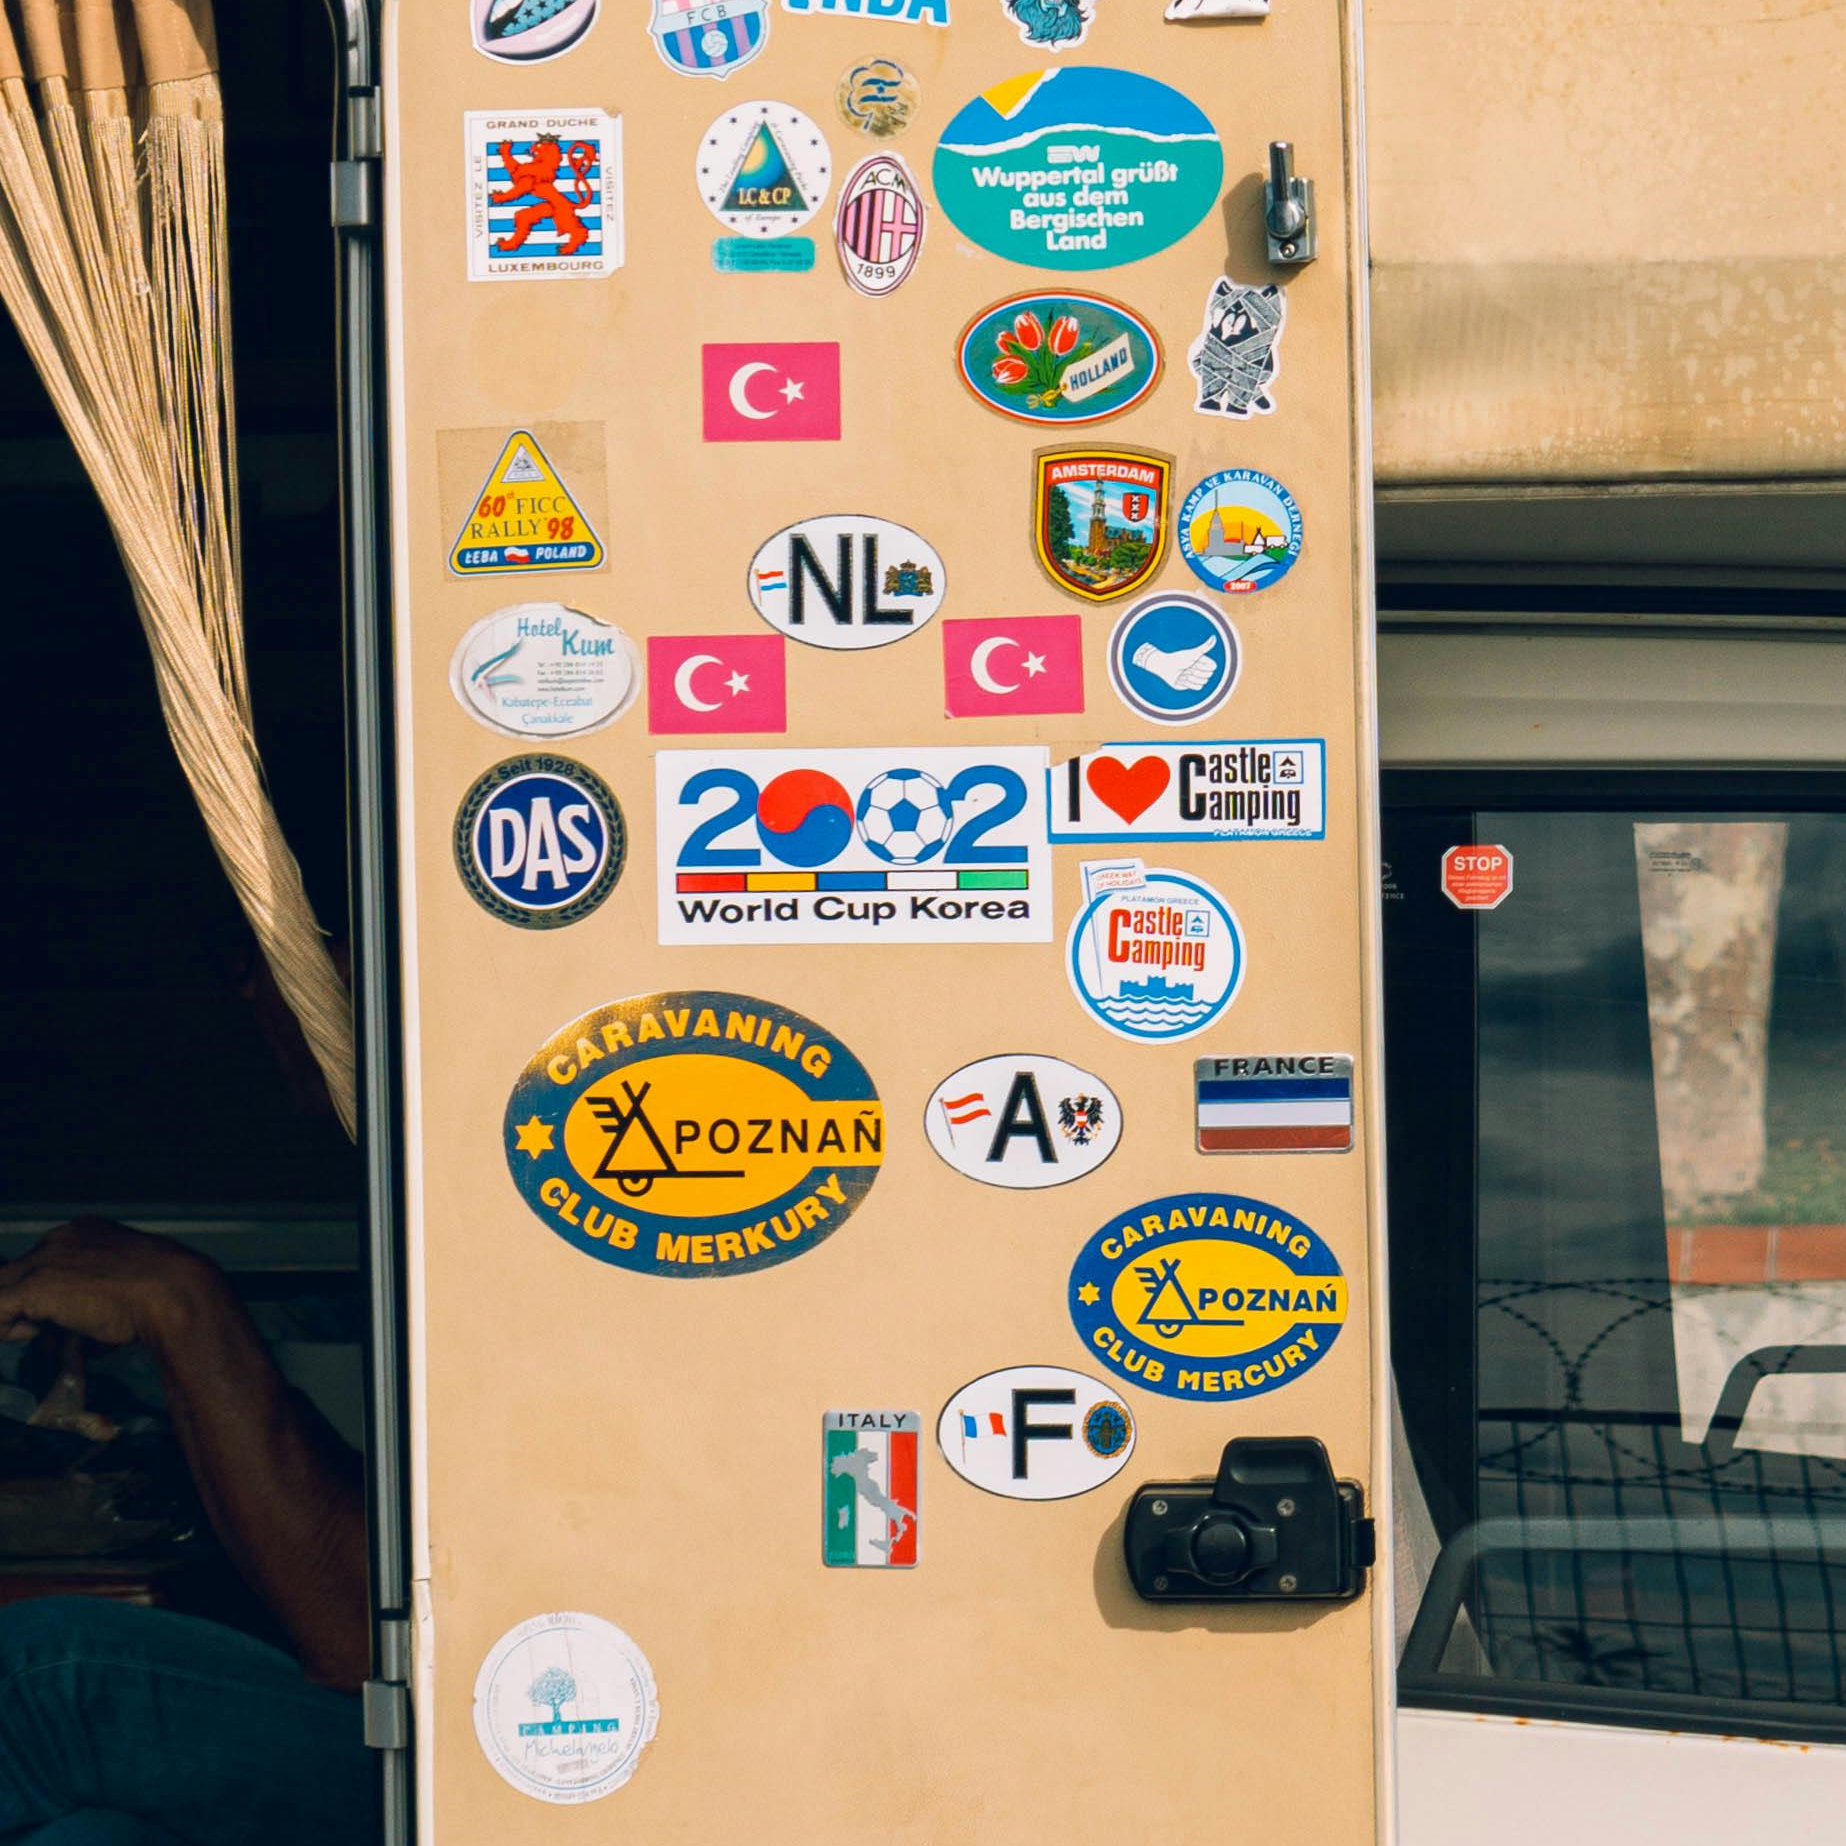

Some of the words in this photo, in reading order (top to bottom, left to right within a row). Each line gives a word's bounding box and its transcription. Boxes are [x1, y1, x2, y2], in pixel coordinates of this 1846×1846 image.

[686, 4, 727, 25] FCB
[486, 119, 539, 130] GRAND
[546, 117, 599, 128] DUCHE
[473, 155, 482, 172] LE
[971, 162, 1105, 191] Wuppertal
[1111, 160, 1178, 188] grüßt
[860, 167, 909, 193] ACM
[605, 166, 615, 222] VISITEZ
[1023, 191, 1067, 207] aus
[1072, 184, 1129, 206] dem
[474, 182, 483, 238] VISITEZ
[1009, 206, 1144, 233] Bergischen
[1046, 228, 1107, 250] Land
[488, 260, 604, 273] LUXEMBOURG
[857, 263, 896, 279] 1899
[1069, 346, 1128, 391] HOLLAND
[1051, 464, 1155, 484] AMSTERDAM
[1205, 476, 1221, 489] VE
[1223, 470, 1284, 495] KARAVAN
[516, 495, 566, 515] FICC
[1181, 487, 1203, 522] KAMP
[470, 518, 542, 540] RALLY
[535, 545, 588, 560] POLAND
[1180, 528, 1195, 559] ASYA
[789, 533, 914, 625] NL
[516, 616, 563, 638] Hotel
[561, 628, 615, 657] Kum
[521, 712, 574, 728] Çanakkale
[497, 759, 532, 780] Seit
[537, 757, 575, 777] 1928
[1067, 756, 1081, 823] I
[488, 796, 597, 891] DAS
[1453, 856, 1503, 872] STOP
[677, 897, 799, 924] World
[812, 896, 897, 926] Cup
[910, 895, 1031, 921] Korea
[1121, 895, 1166, 904] PLATAMON
[1167, 897, 1200, 905] GREECE
[545, 1008, 833, 1086] CARAVANING
[1214, 1056, 1336, 1078] FRANCE
[985, 1070, 1059, 1164] A
[538, 1176, 640, 1251] CLUB
[655, 1172, 848, 1265] MERKURY
[1100, 1206, 1312, 1260] CARAVANING
[1198, 1282, 1338, 1313] POZNAŃ
[1092, 1325, 1164, 1383] CLUB
[1176, 1327, 1322, 1393] MERCURY
[838, 1412, 908, 1429] ITALY
[1012, 1388, 1076, 1480] F
[521, 1721, 618, 1735] CAMPING
